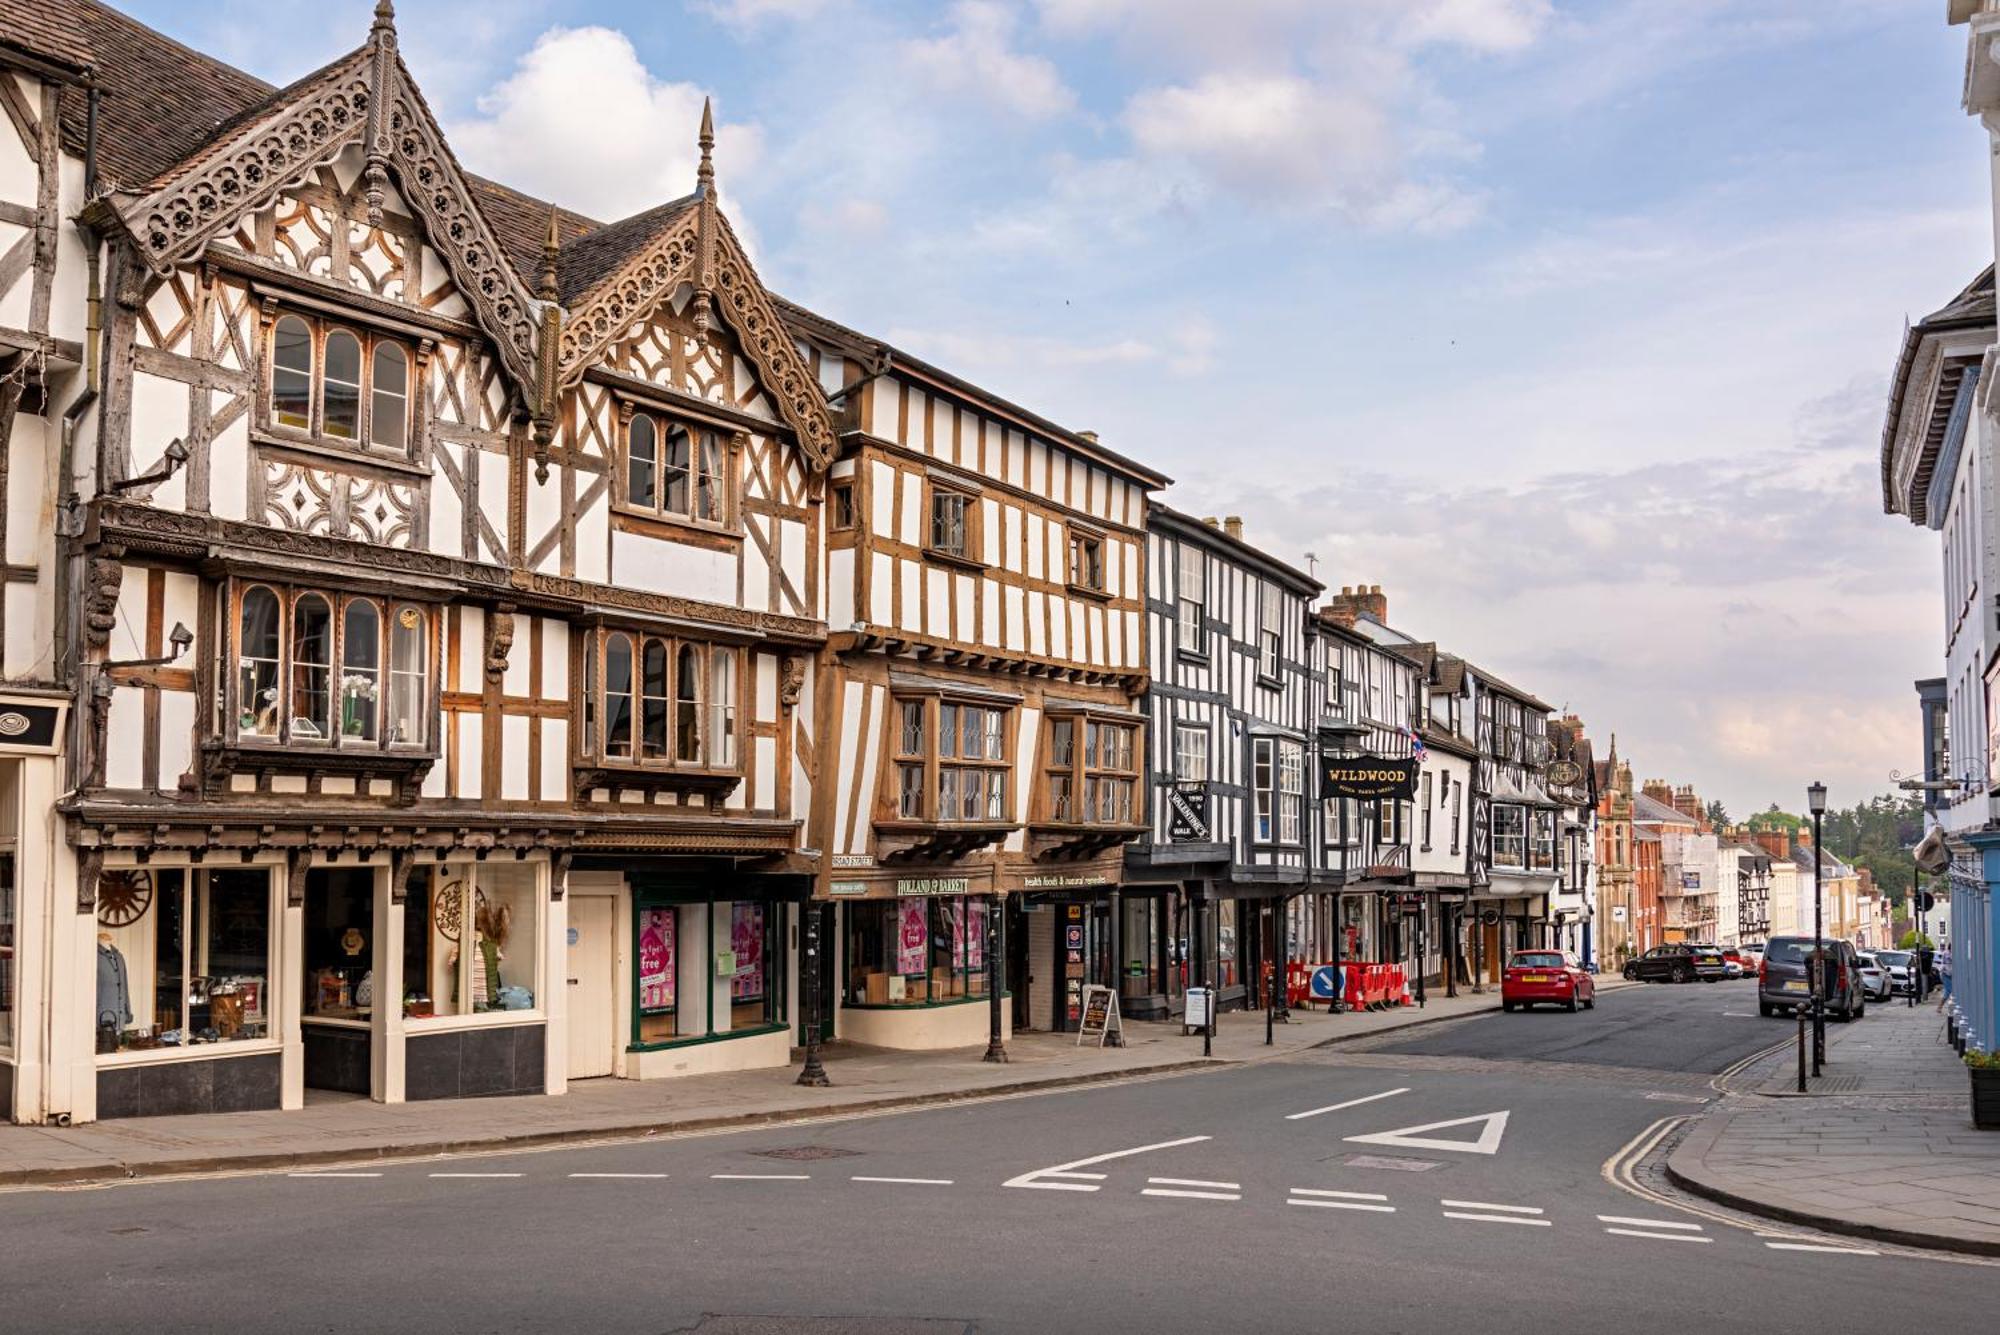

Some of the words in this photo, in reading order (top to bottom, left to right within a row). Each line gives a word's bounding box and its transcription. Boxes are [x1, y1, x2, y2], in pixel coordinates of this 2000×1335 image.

[1328, 770, 1406, 782] WILDWOOD
[850, 857, 873, 865] STREET
[897, 879, 930, 896] HOLLAND
[939, 879, 969, 894] BARRETT
[1024, 877, 1042, 887] health
[1043, 877, 1058, 886] foods
[1059, 876, 1064, 886] &
[1065, 876, 1084, 885] natural
[641, 955, 660, 970] free
